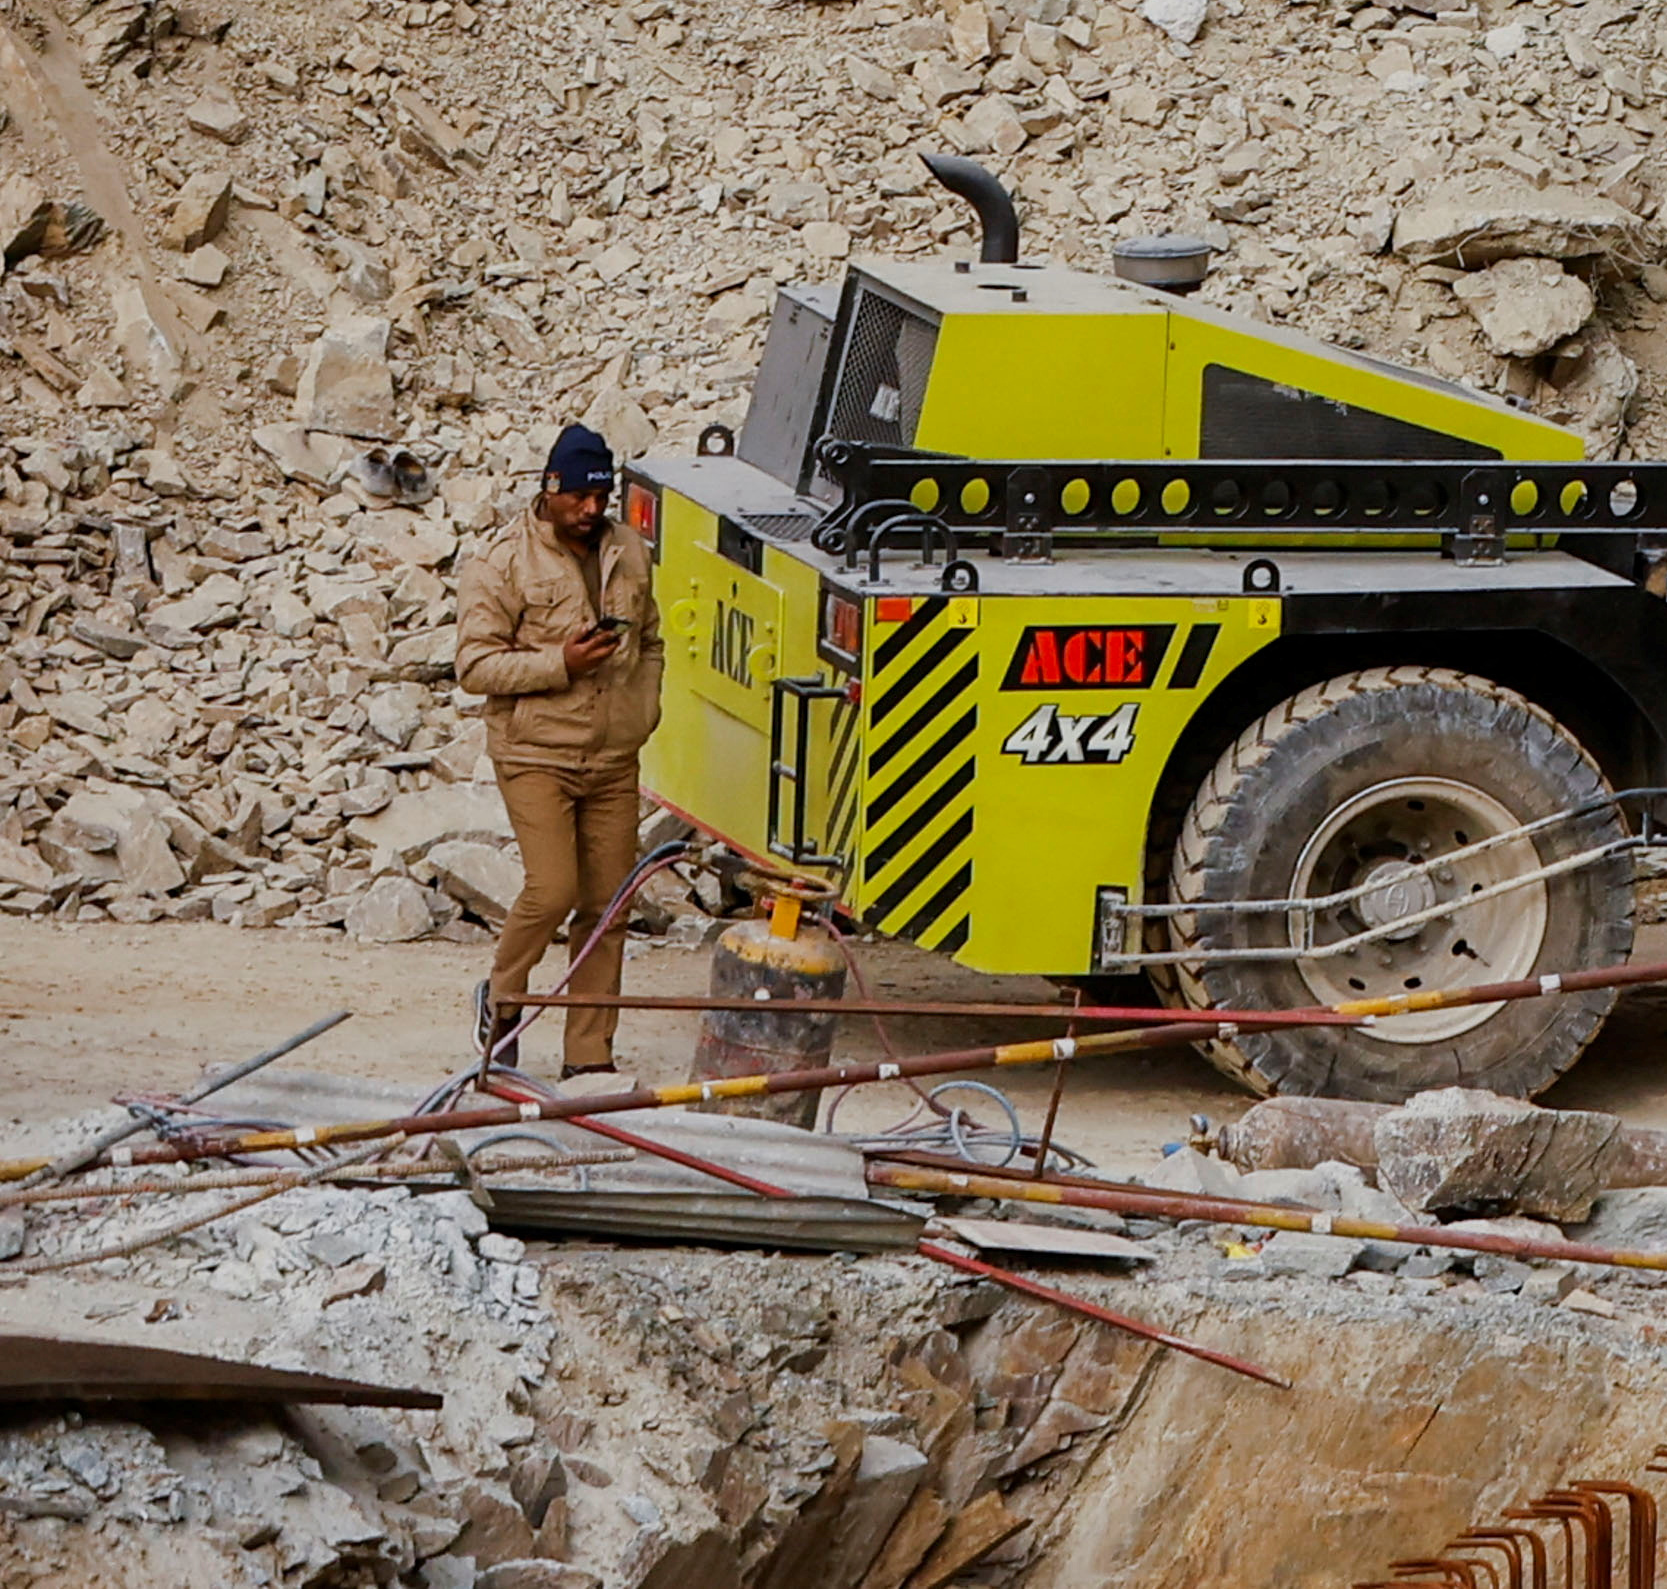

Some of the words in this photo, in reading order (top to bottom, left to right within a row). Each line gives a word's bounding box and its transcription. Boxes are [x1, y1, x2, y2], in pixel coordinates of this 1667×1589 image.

[711, 599, 755, 689] ACE
[1020, 630, 1146, 685] ACE
[1003, 703, 1139, 764] 4x4
